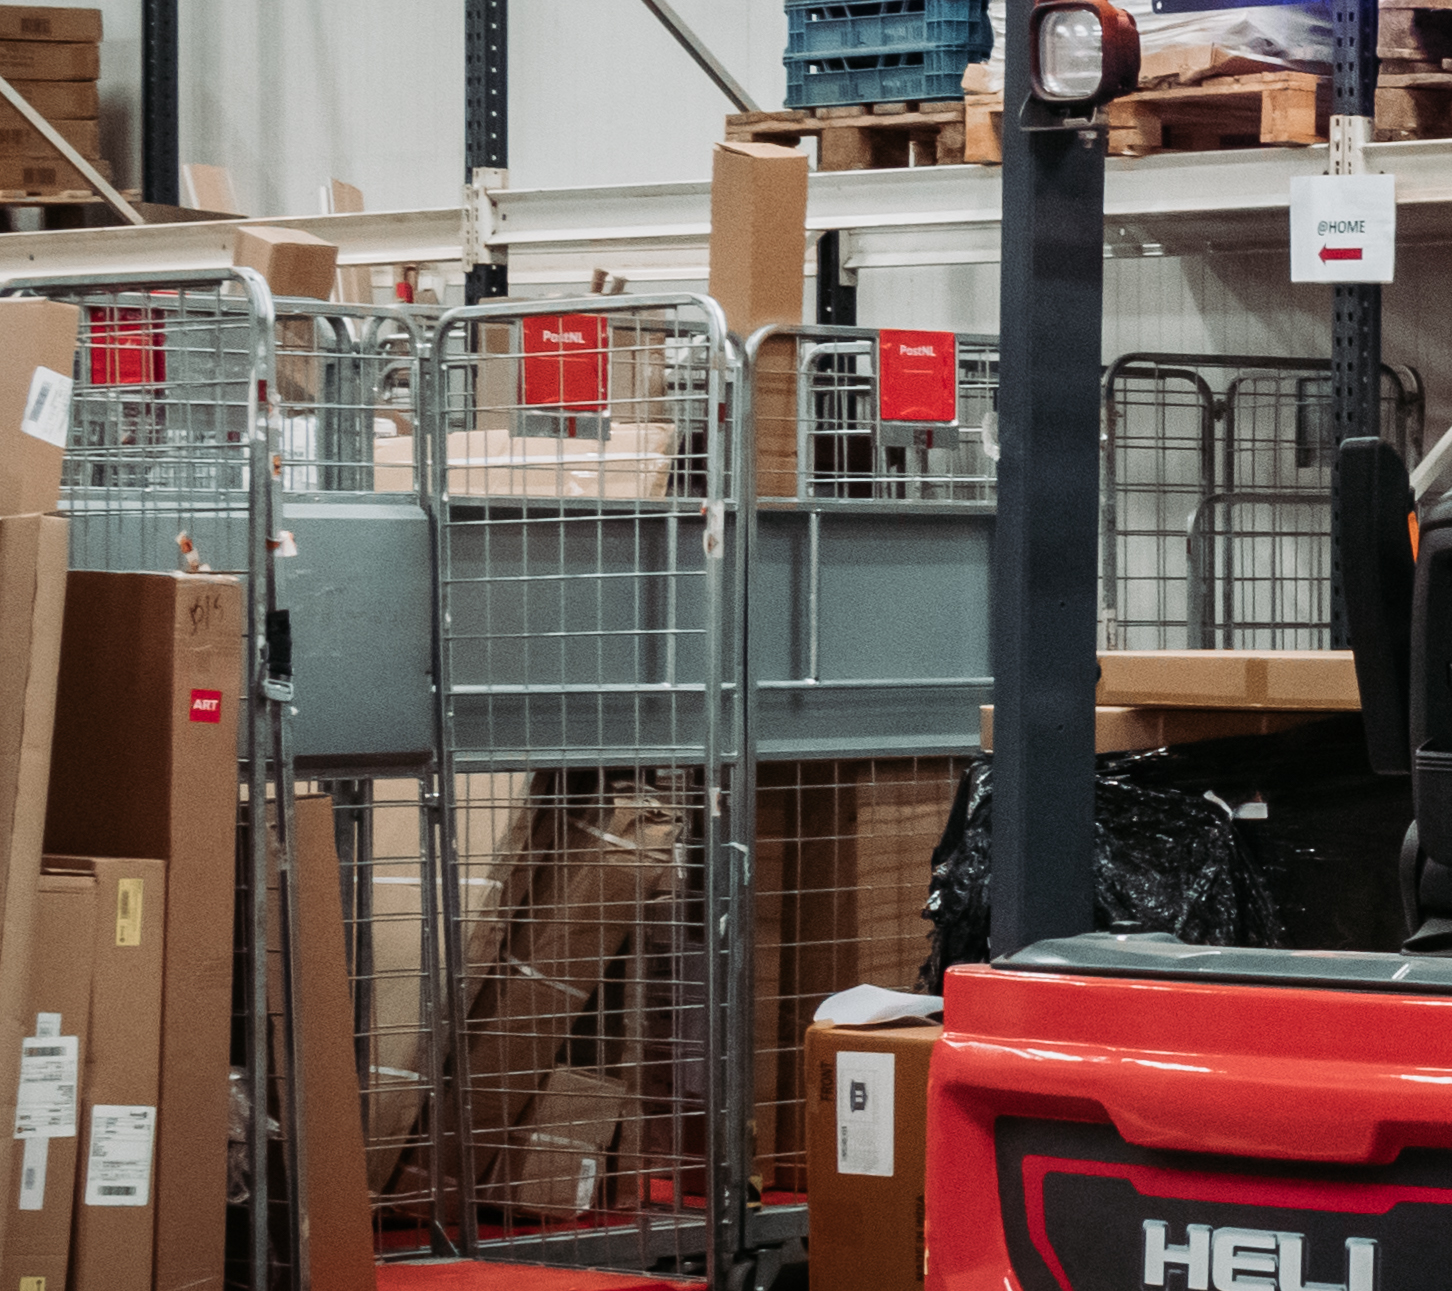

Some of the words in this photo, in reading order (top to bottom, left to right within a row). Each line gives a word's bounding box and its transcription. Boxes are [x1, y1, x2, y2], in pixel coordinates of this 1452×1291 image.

[1317, 220, 1365, 236] @HOME
[542, 330, 586, 344] PostNL
[899, 344, 937, 357] PostNL
[192, 698, 219, 711] ART
